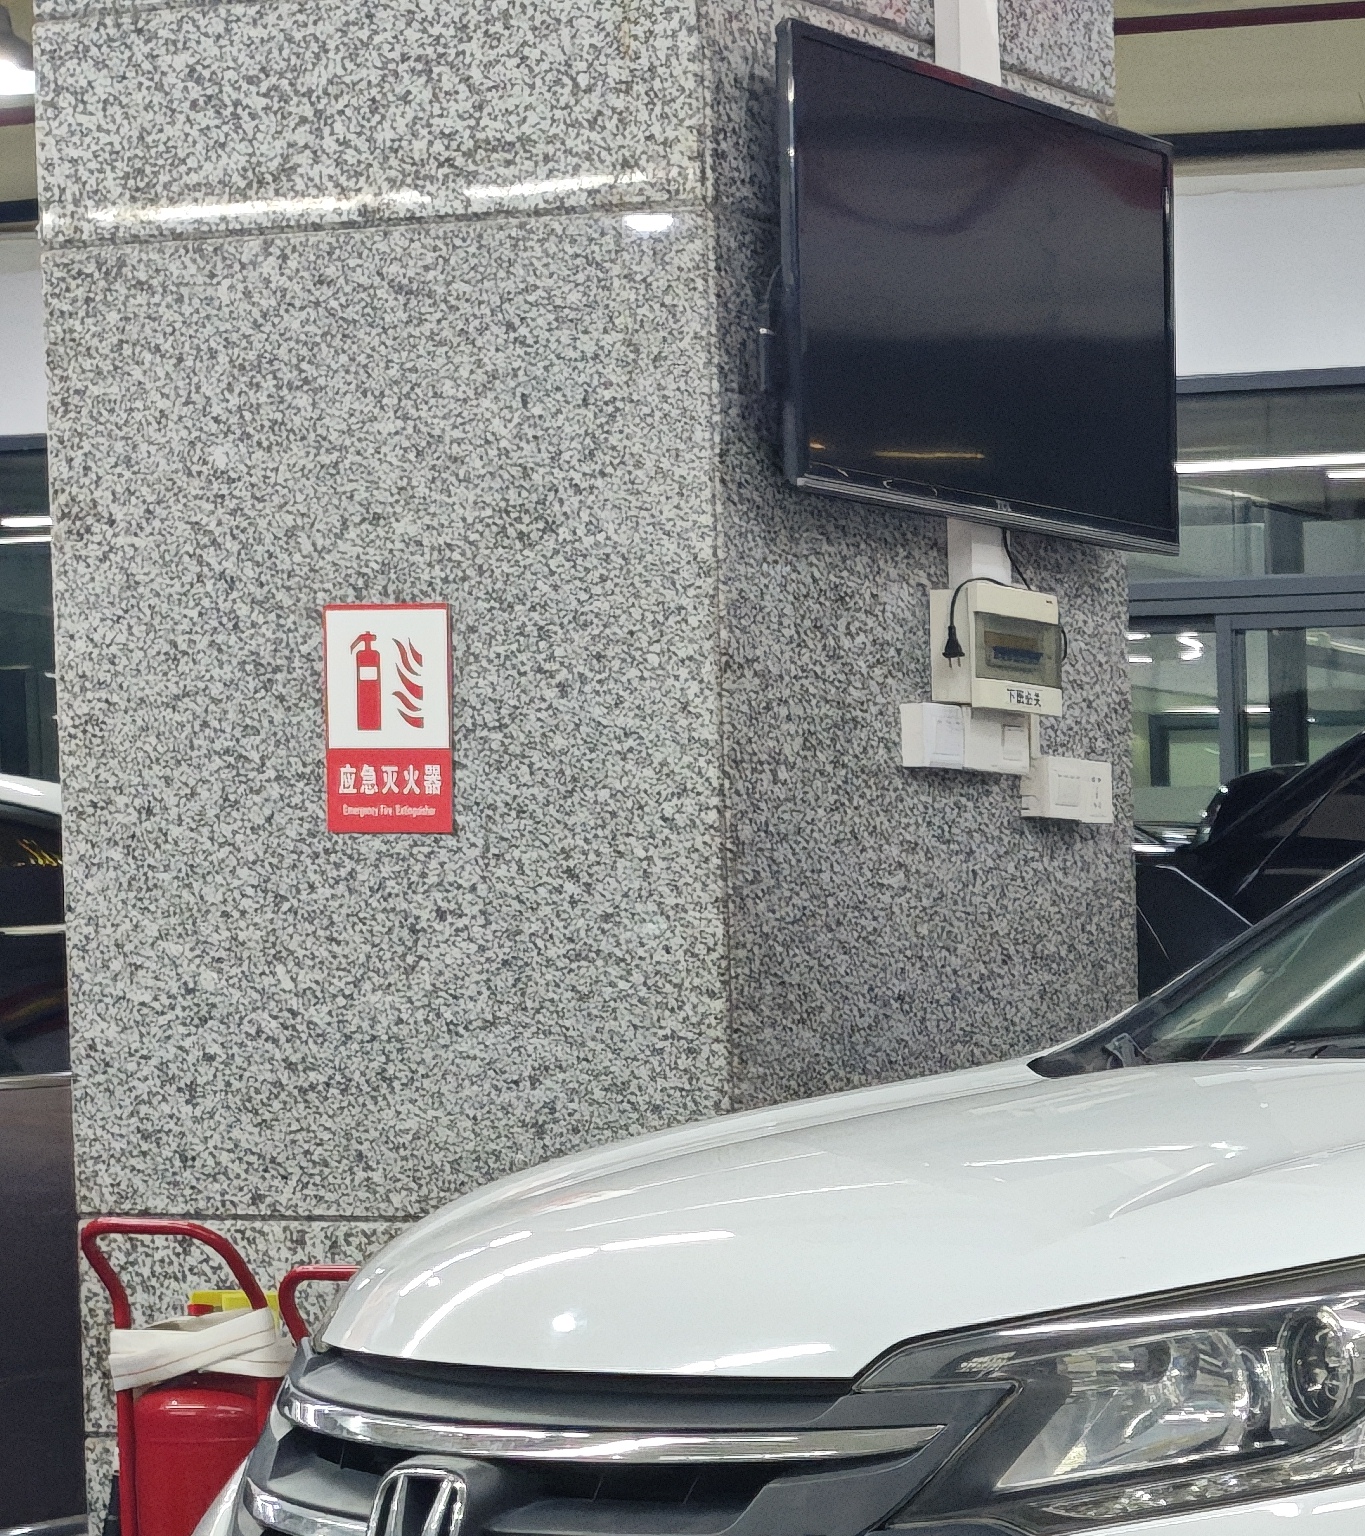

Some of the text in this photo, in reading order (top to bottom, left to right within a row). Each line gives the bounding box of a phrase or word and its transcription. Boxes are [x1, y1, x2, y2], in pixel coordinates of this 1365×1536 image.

[338, 763, 442, 795] 应急灭火器
